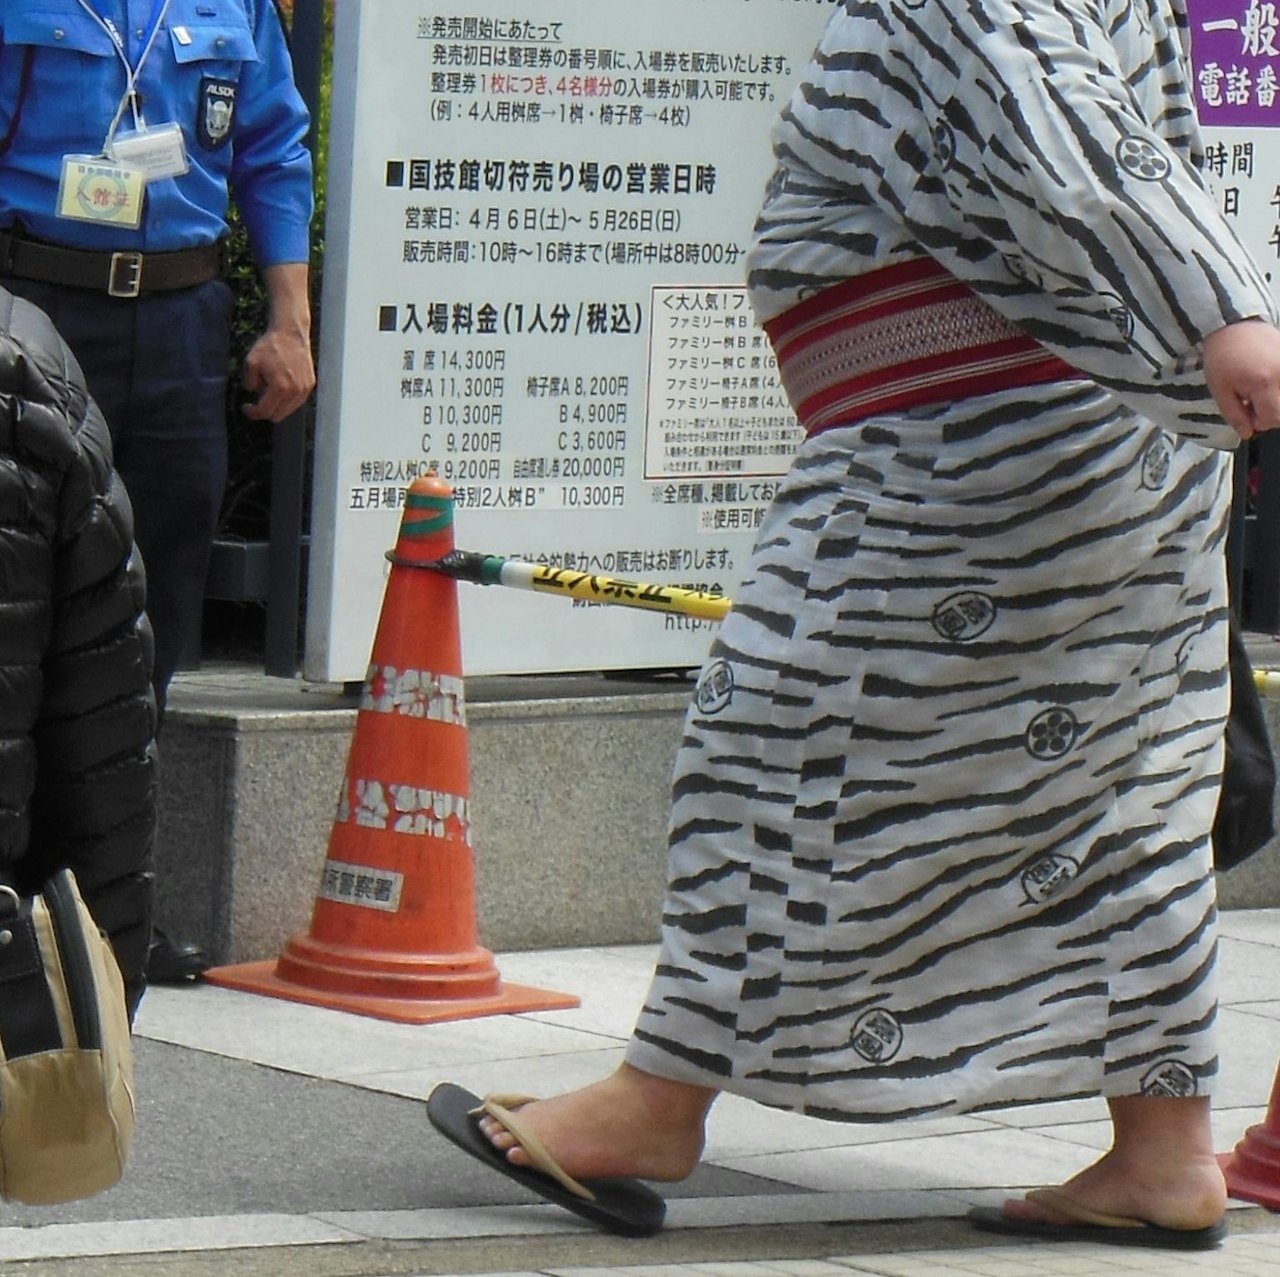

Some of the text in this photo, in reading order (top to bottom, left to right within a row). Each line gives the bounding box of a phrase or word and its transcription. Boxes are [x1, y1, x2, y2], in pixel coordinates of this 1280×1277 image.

[408, 159, 716, 195] 国技館切符売り場の営業日時
[663, 293, 752, 311] <大人気!フ
[441, 349, 506, 371] 14,300円
[440, 377, 505, 398] 11,300円
[575, 376, 628, 397] 8,200円
[439, 404, 502, 426] 10,300円
[572, 403, 627, 424] 4,900円
[447, 432, 501, 453] 9,200円
[572, 430, 626, 451] 3,600円
[444, 459, 500, 480] 9,200円
[561, 486, 624, 507] 10,300円
